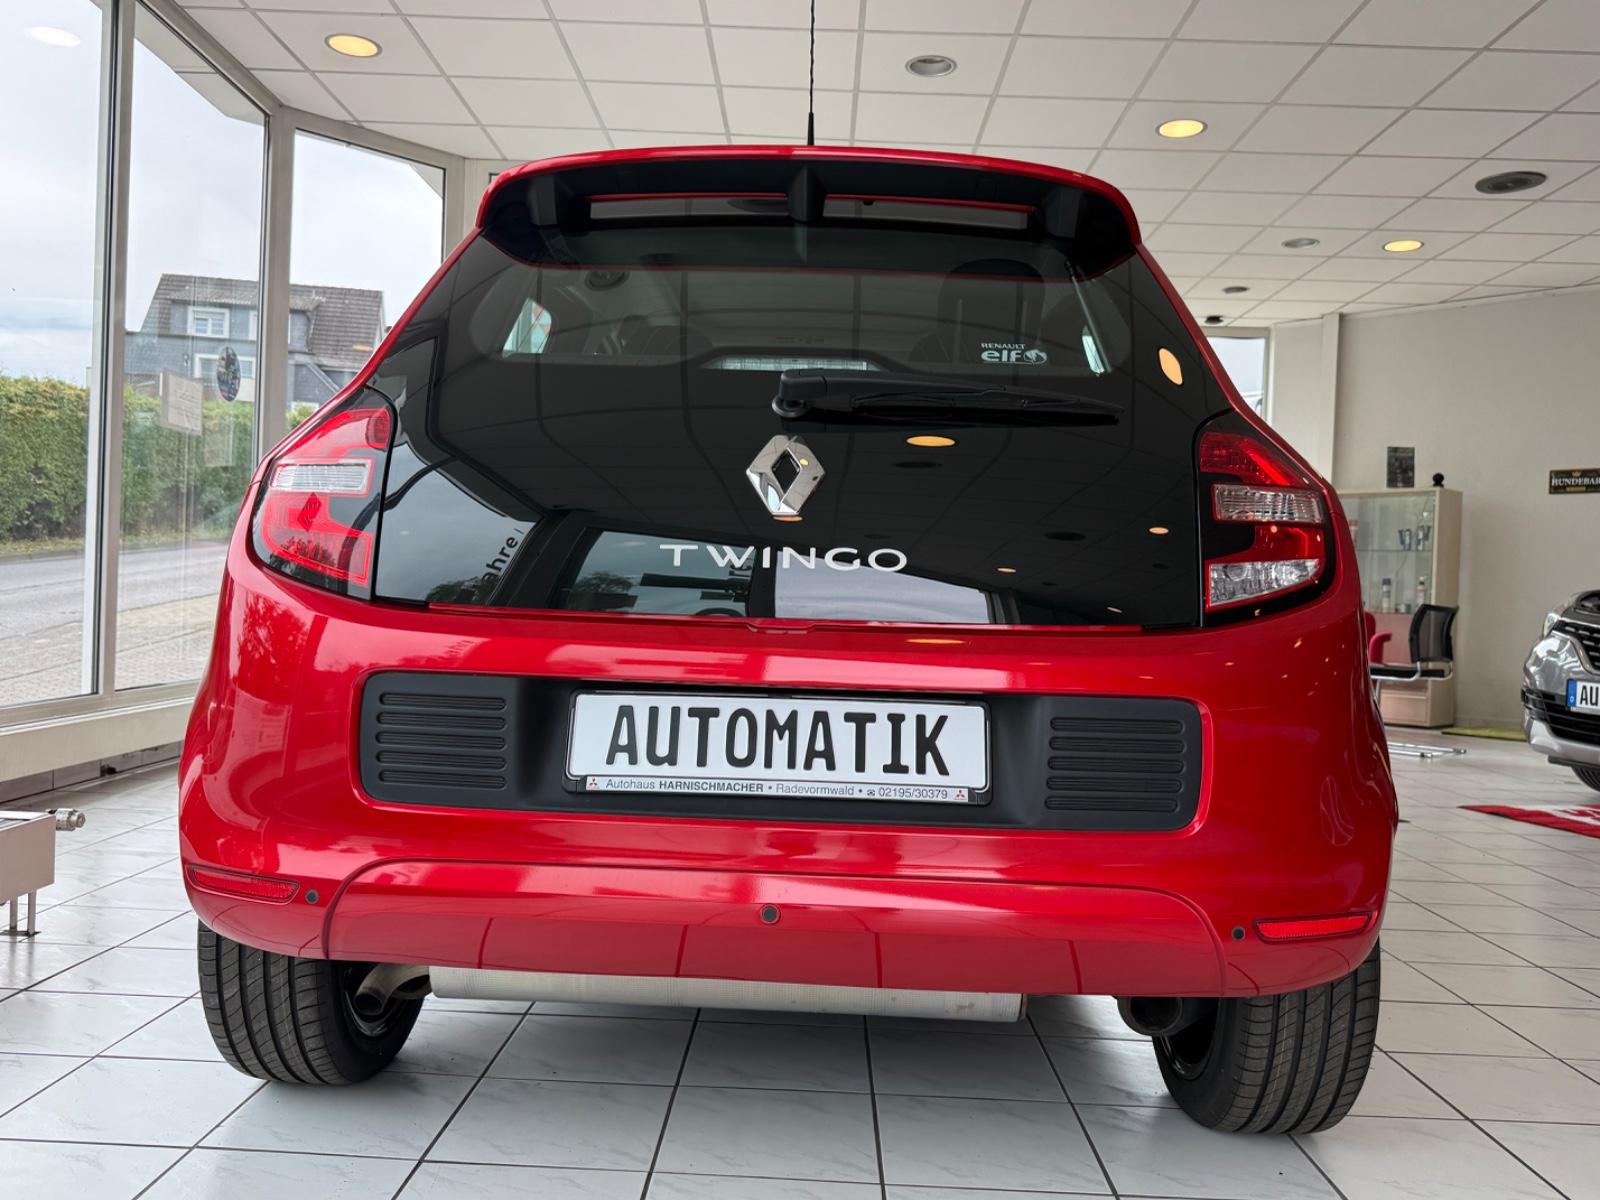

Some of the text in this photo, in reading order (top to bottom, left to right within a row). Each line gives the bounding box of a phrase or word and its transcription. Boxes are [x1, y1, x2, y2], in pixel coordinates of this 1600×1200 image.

[981, 350, 1022, 362] elf
[660, 544, 908, 572] TWINGO
[1580, 685, 1599, 707] AU
[605, 704, 950, 776] AUTOMATIK
[605, 778, 948, 799] Autohaus HARNISCHMACHER Radevormwald 02195/30379
